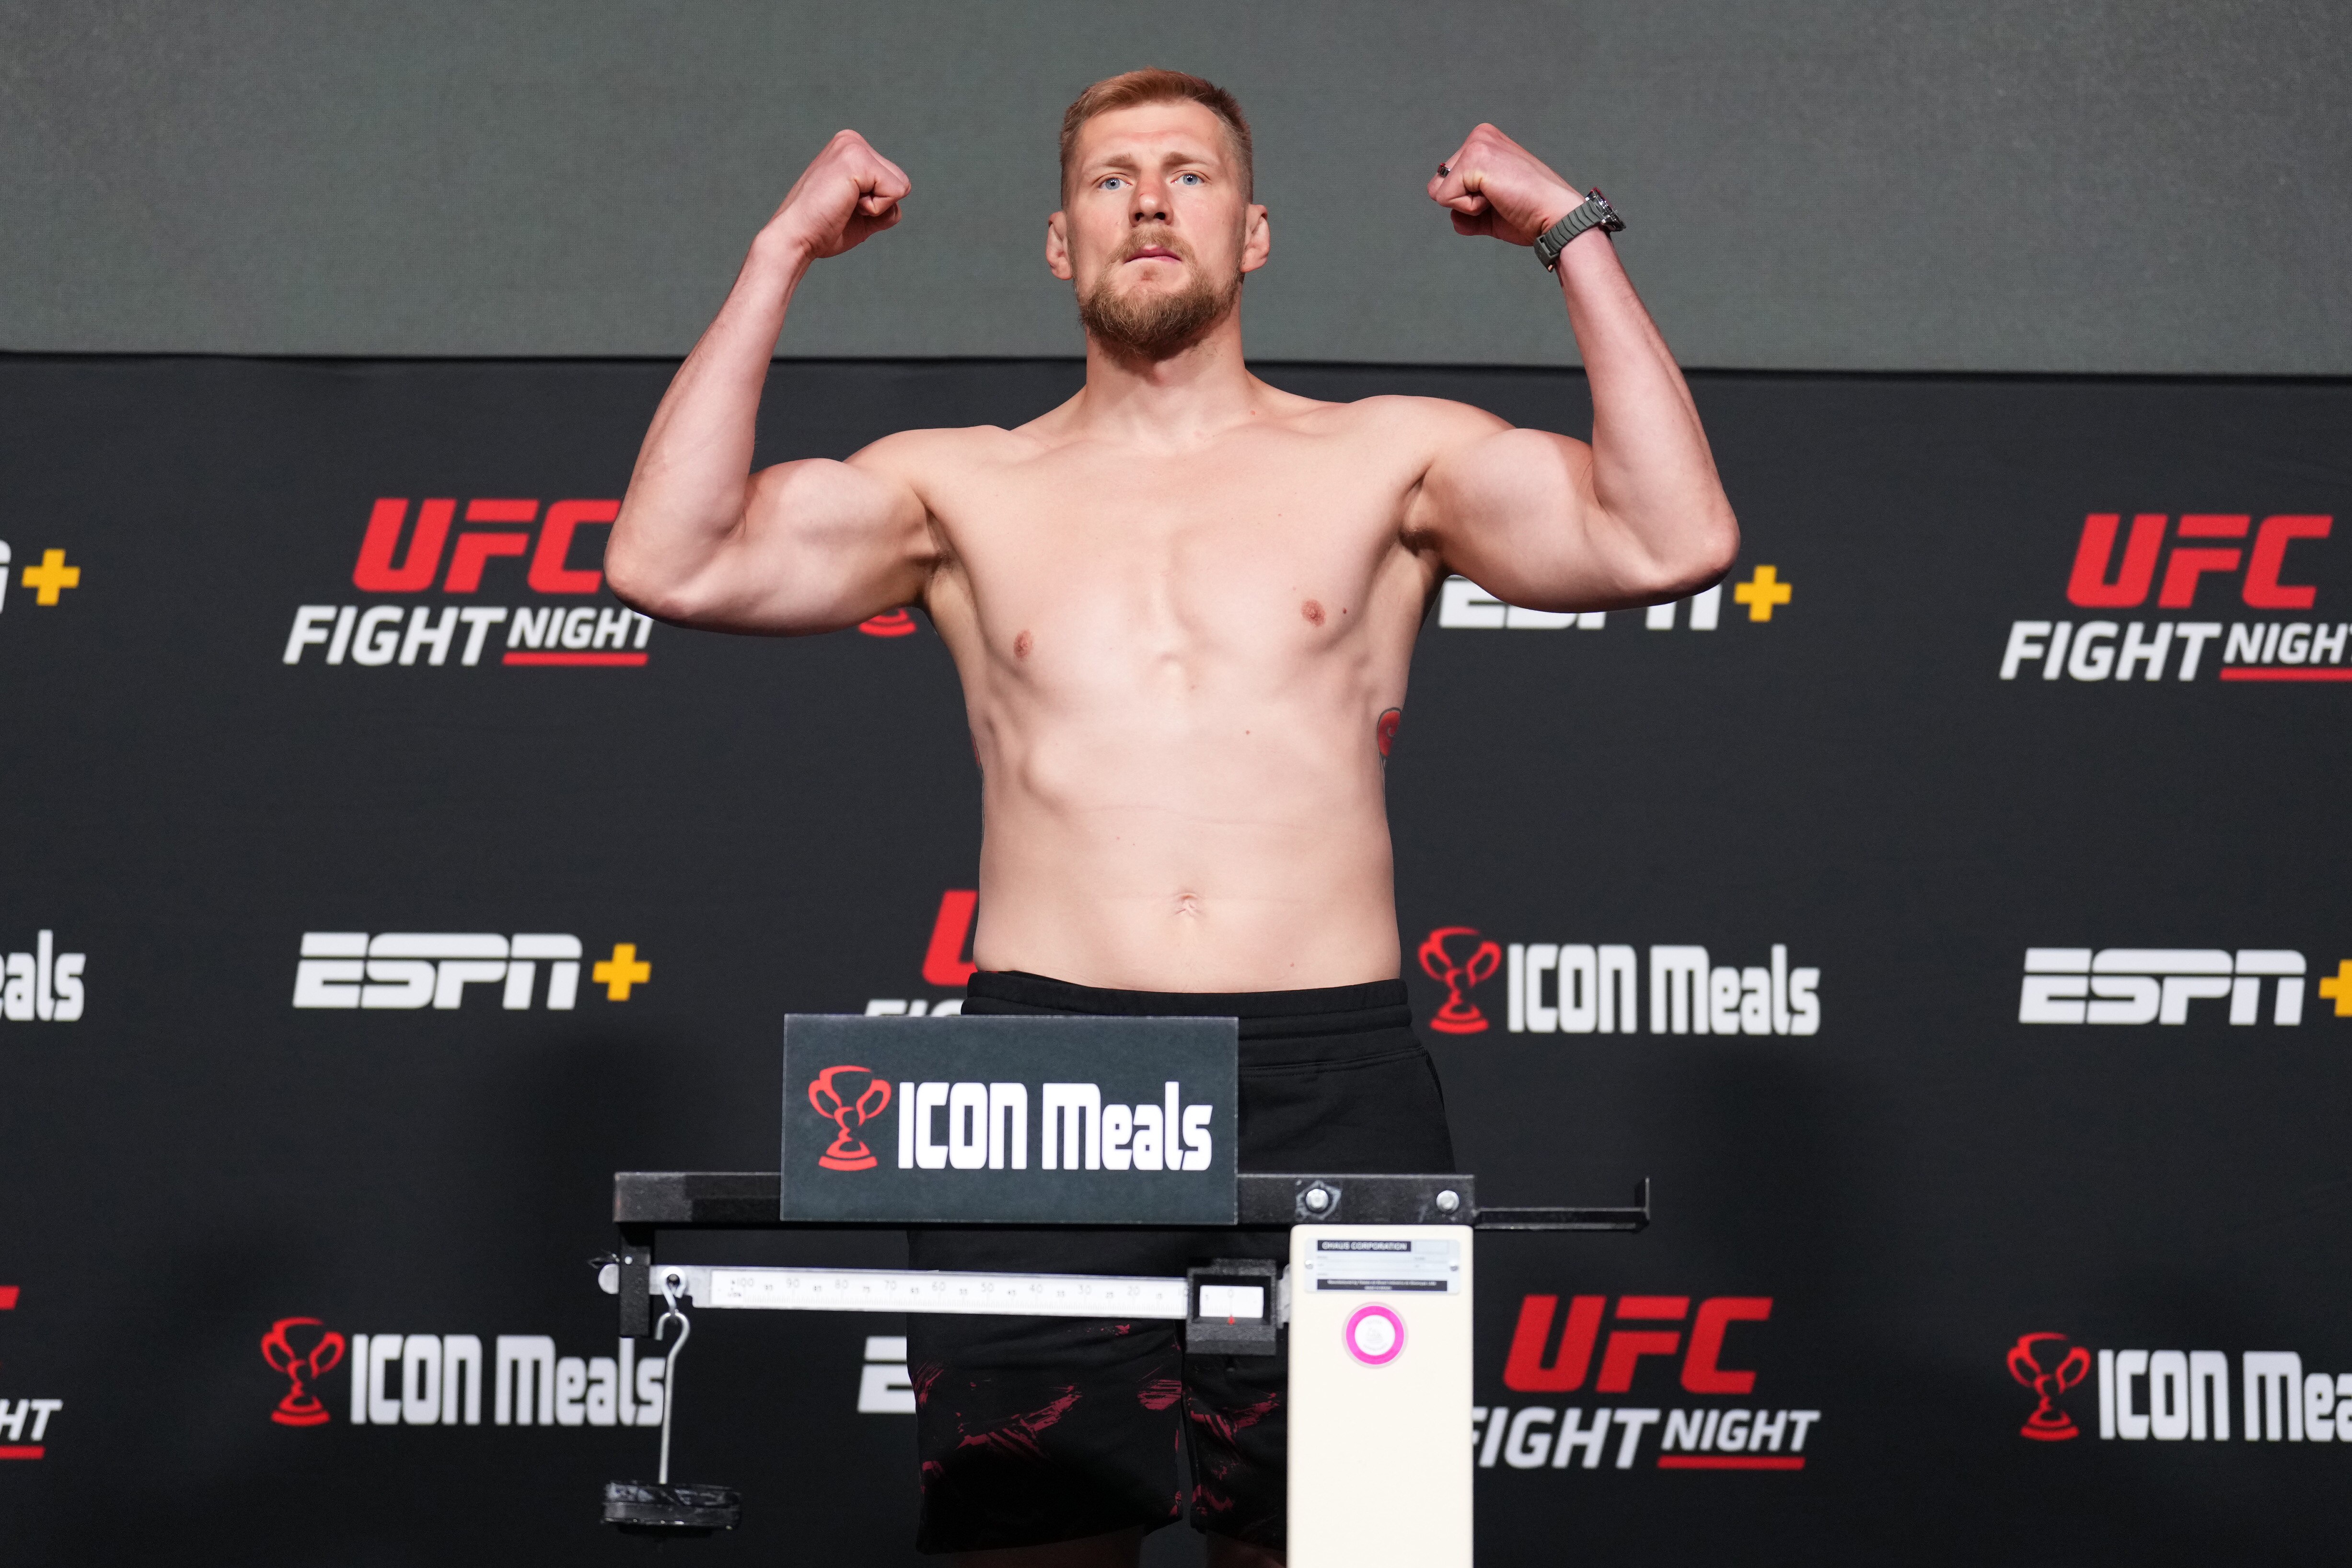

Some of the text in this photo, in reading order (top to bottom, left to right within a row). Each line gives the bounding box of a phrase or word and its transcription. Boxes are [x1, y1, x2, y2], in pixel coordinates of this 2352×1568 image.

[353, 498, 621, 593] UFC
[2067, 514, 2333, 608] UFC
[283, 605, 654, 665] FIGHT NIGHT
[2000, 621, 2352, 681] FIGHT NIGH
[0, 930, 85, 1021] als
[1508, 944, 1820, 1035] ICON Meals
[898, 1081, 1213, 1171] ICON Meals
[351, 1335, 666, 1425] ICON Meals
[1505, 1296, 1772, 1393] UFC
[1473, 1406, 1820, 1469] IGHT NIGHT
[2098, 1350, 2229, 1440] ICON
